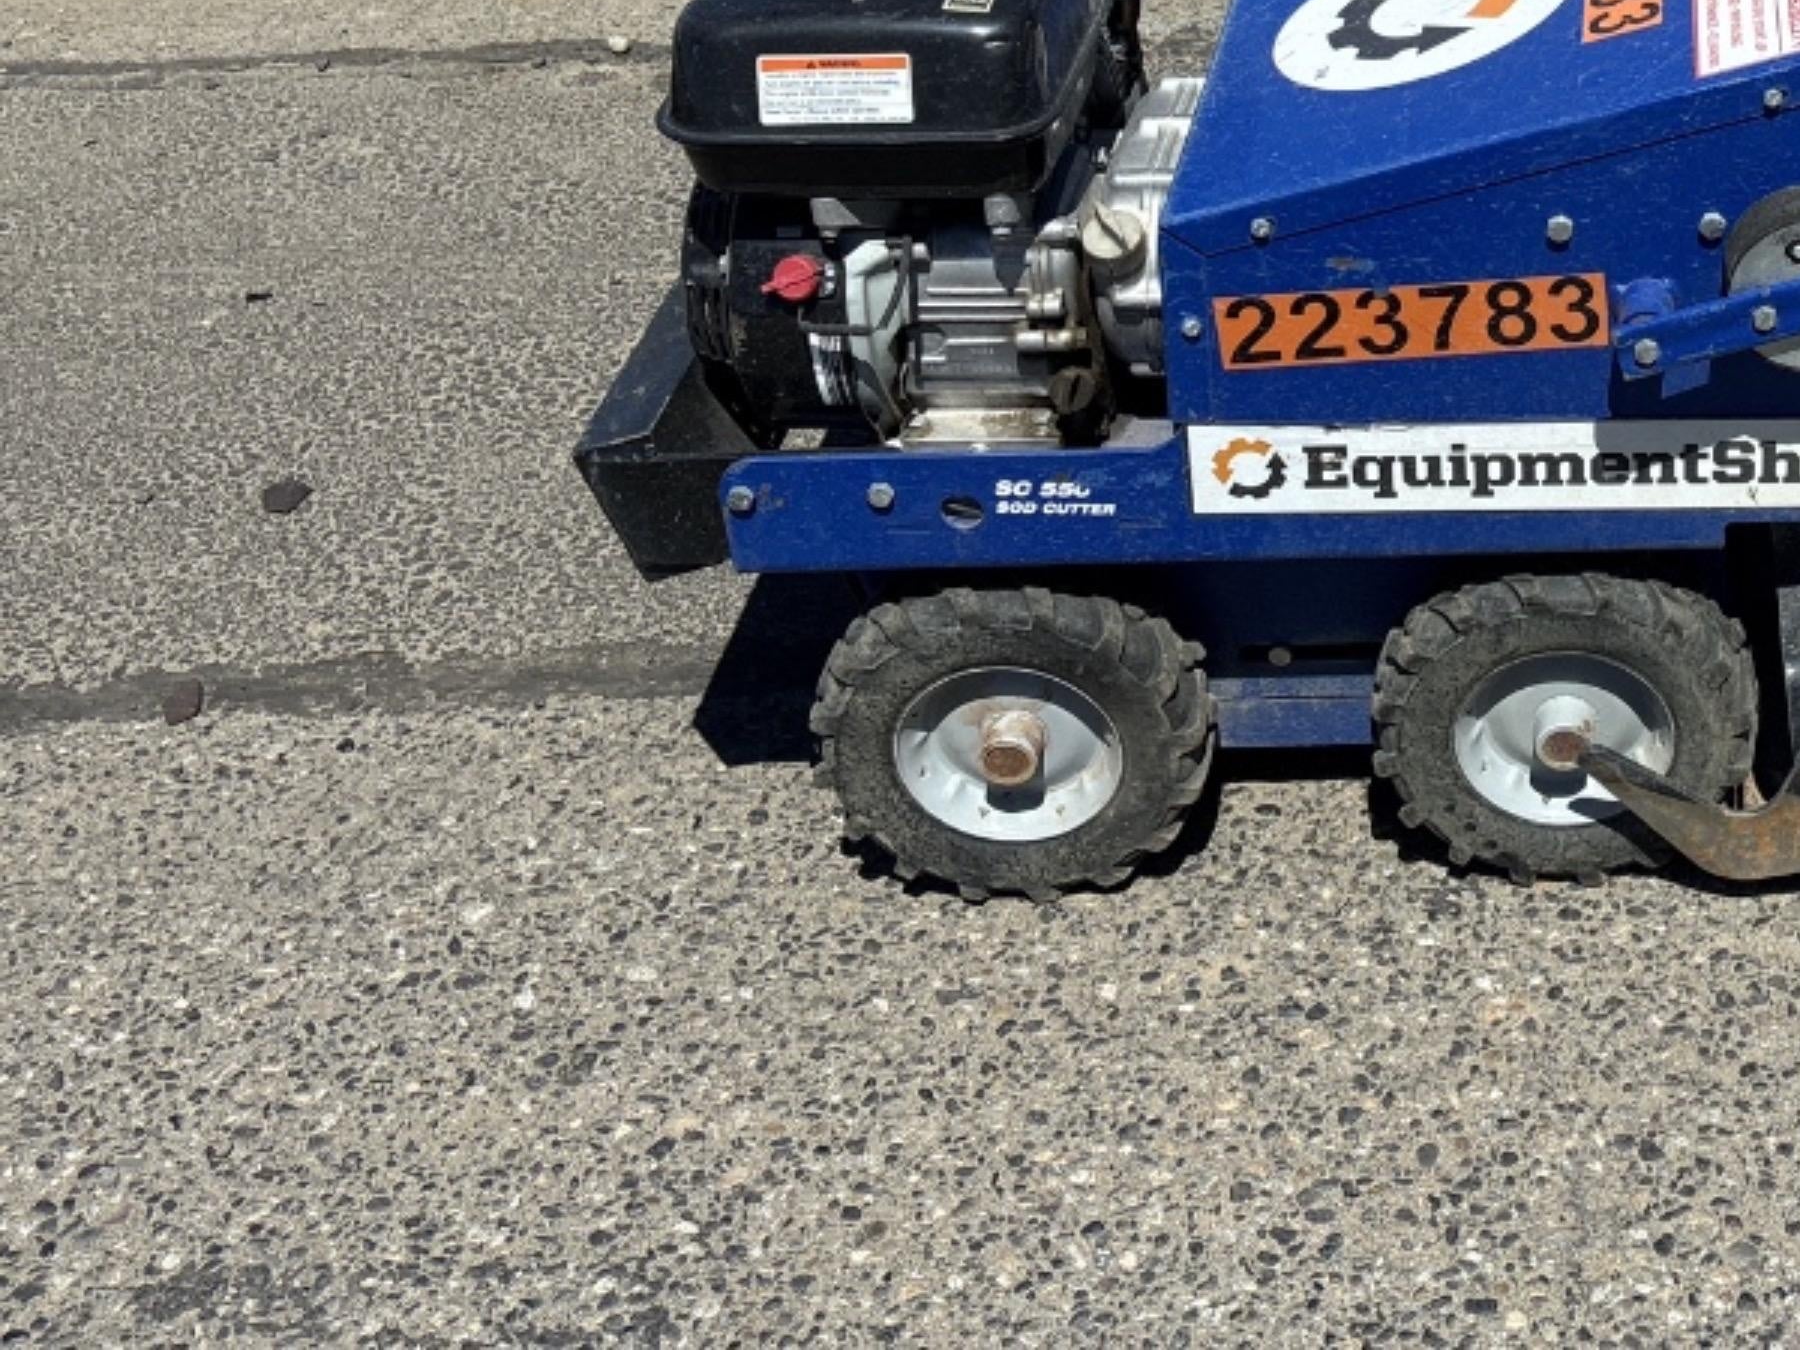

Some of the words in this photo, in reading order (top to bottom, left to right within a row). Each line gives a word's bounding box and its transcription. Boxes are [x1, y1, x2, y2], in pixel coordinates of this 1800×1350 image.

[1223, 274, 1602, 366] 223783
[994, 479, 1033, 497] SC
[995, 500, 1038, 515] SOD
[1042, 502, 1117, 517] CUTTER
